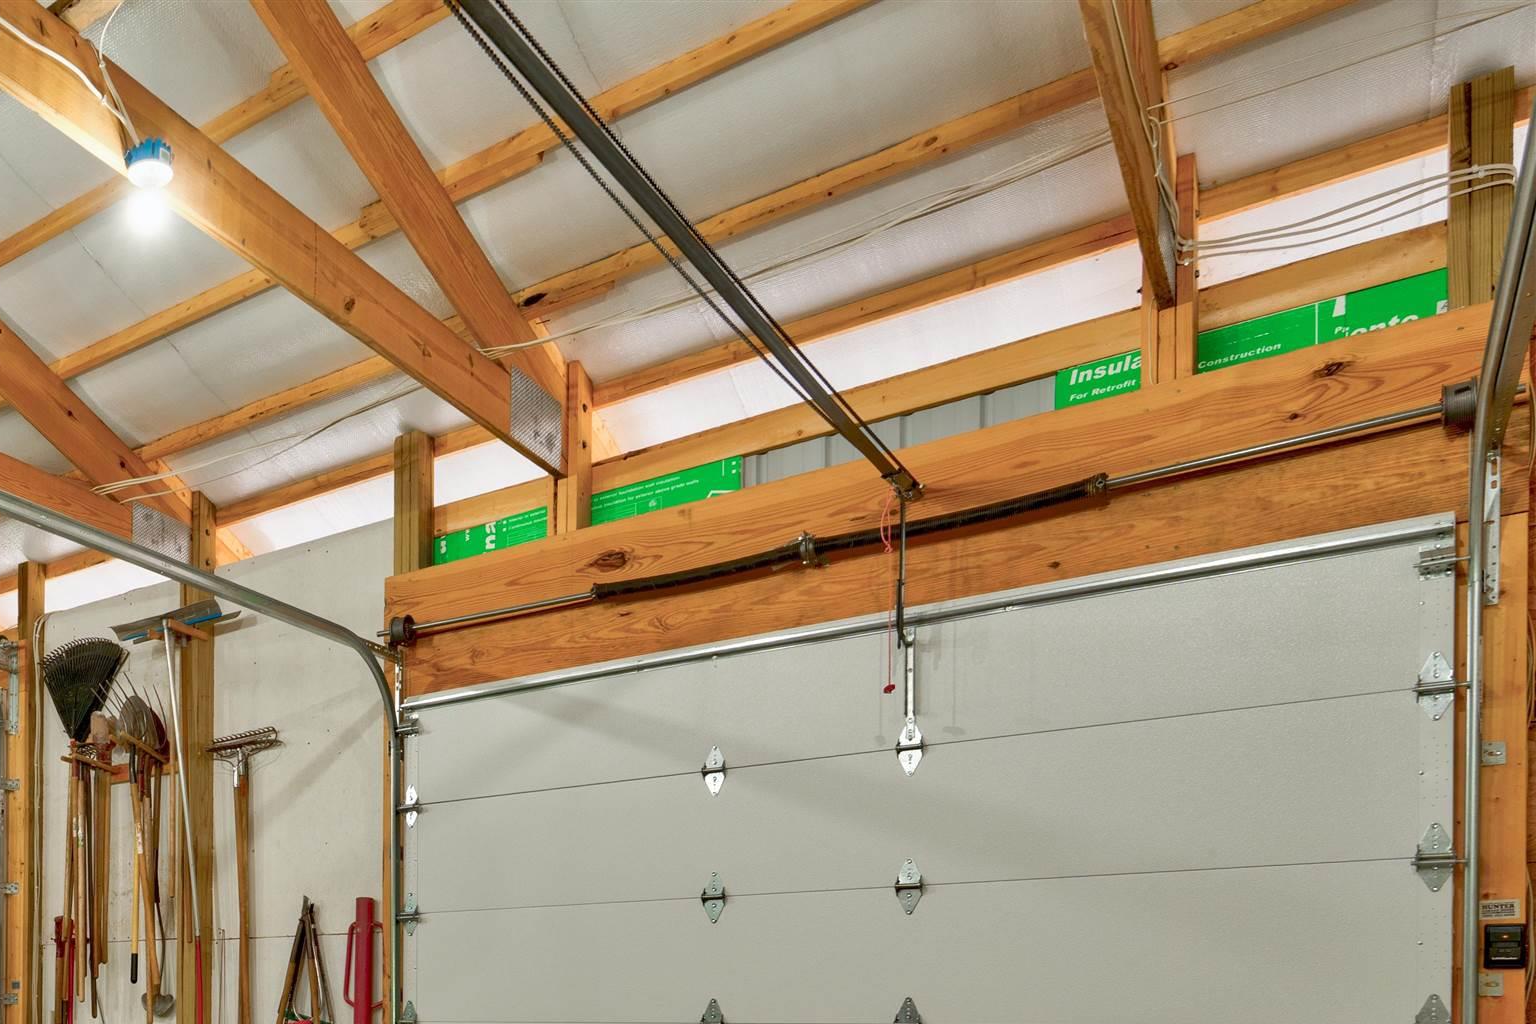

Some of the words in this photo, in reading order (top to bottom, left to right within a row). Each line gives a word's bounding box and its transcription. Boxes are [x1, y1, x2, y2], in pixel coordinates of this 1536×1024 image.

[1198, 343, 1281, 369] Construction
[1069, 392, 1089, 402] For
[1091, 379, 1137, 396] Retrofit
